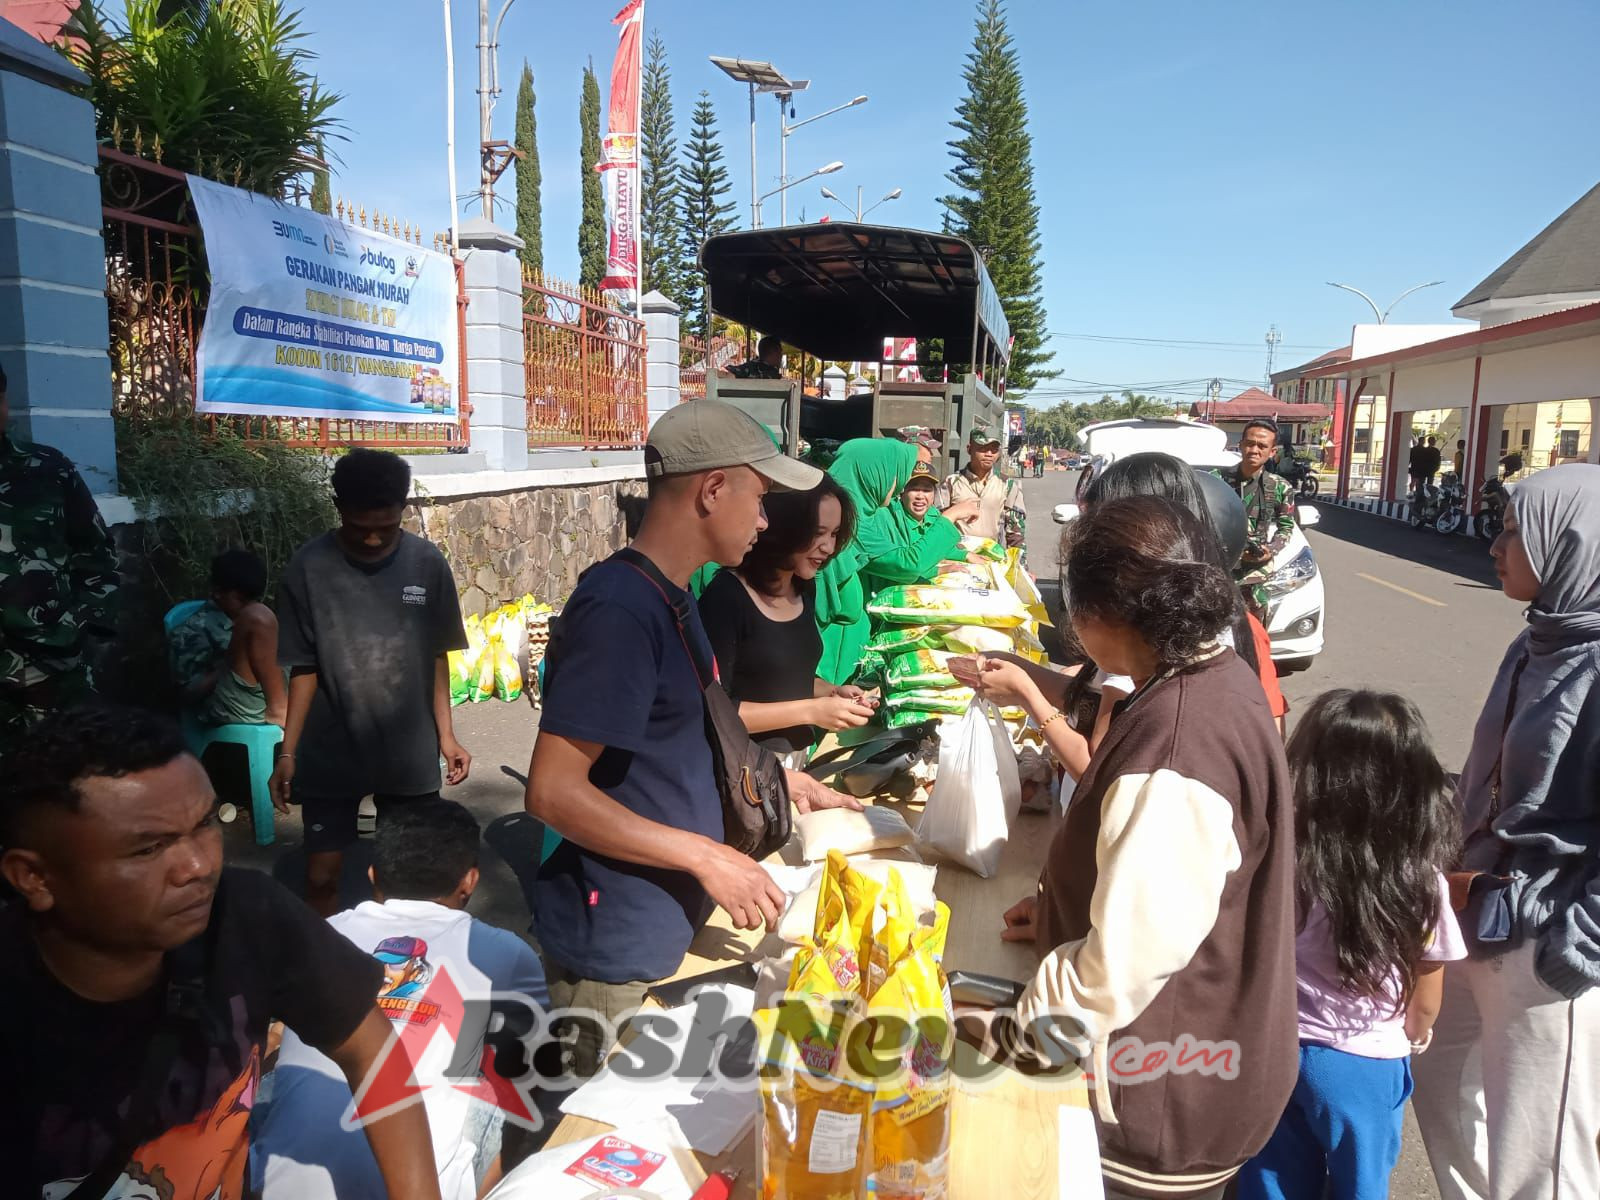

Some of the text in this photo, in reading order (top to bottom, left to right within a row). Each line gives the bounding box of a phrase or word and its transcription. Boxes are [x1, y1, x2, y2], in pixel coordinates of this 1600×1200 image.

[617, 169, 628, 259] DIRGAHAYU
[285, 255, 410, 305] GERAKAN PANGAN MURAH
[367, 247, 396, 275] bulog
[242, 312, 437, 360] Dalam Rangka Stabilitas Pasokan Dan Harga Pangan
[275, 344, 322, 370] KODIM
